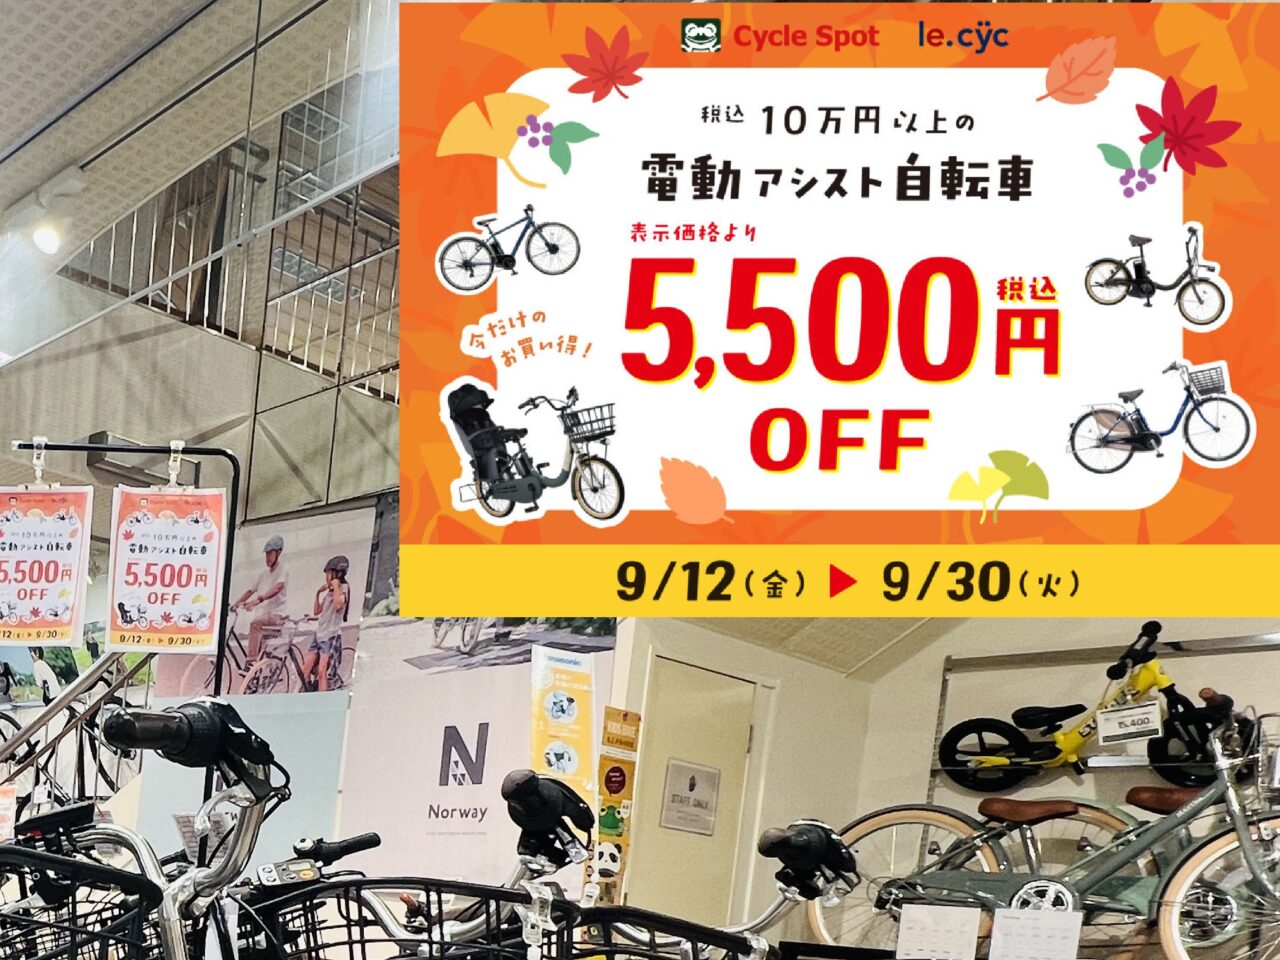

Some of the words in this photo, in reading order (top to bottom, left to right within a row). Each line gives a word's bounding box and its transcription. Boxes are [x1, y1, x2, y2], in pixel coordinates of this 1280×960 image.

[17, 588, 49, 601] OFF
[148, 591, 182, 606] OFF
[671, 793, 690, 806] STAFF
[427, 803, 489, 823] Norway
